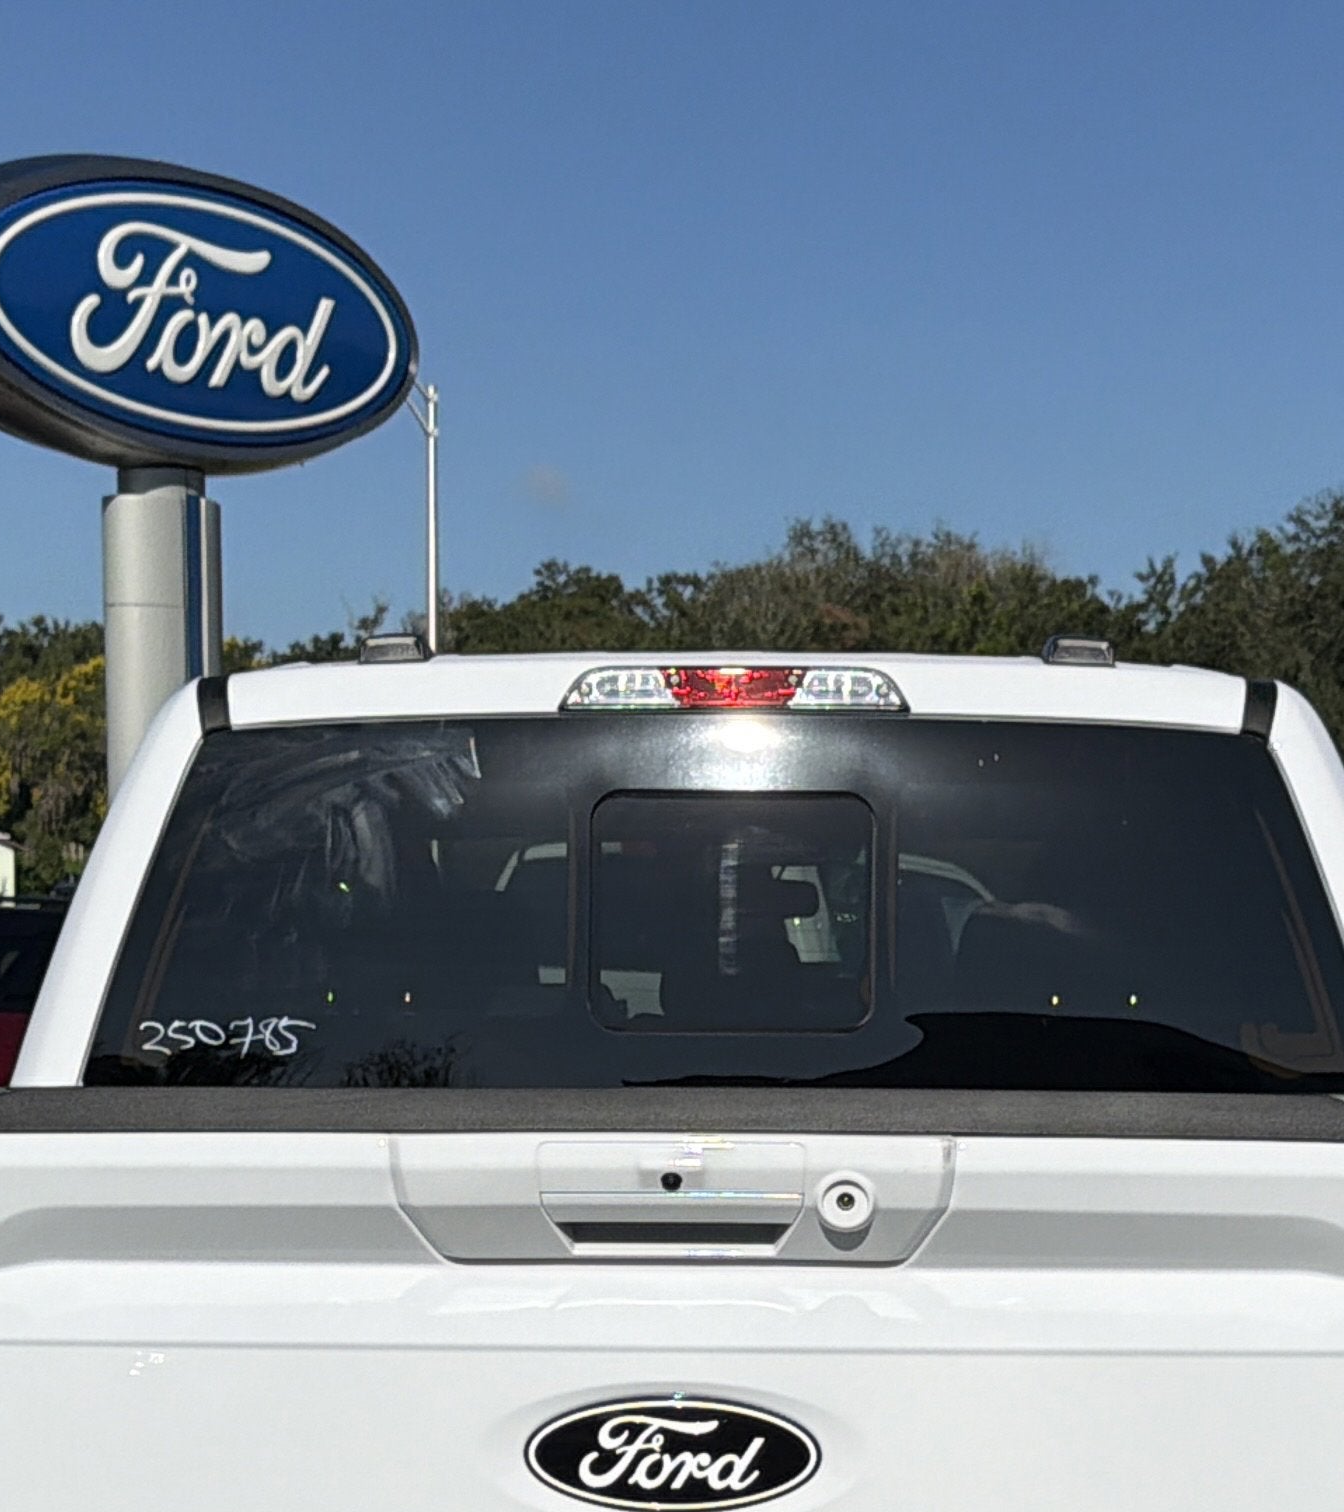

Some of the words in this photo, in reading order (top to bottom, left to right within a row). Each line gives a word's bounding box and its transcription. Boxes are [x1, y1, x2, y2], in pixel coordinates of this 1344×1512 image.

[70, 221, 336, 402] Ford
[139, 1016, 316, 1059] 250785
[578, 1414, 766, 1491] Ford
